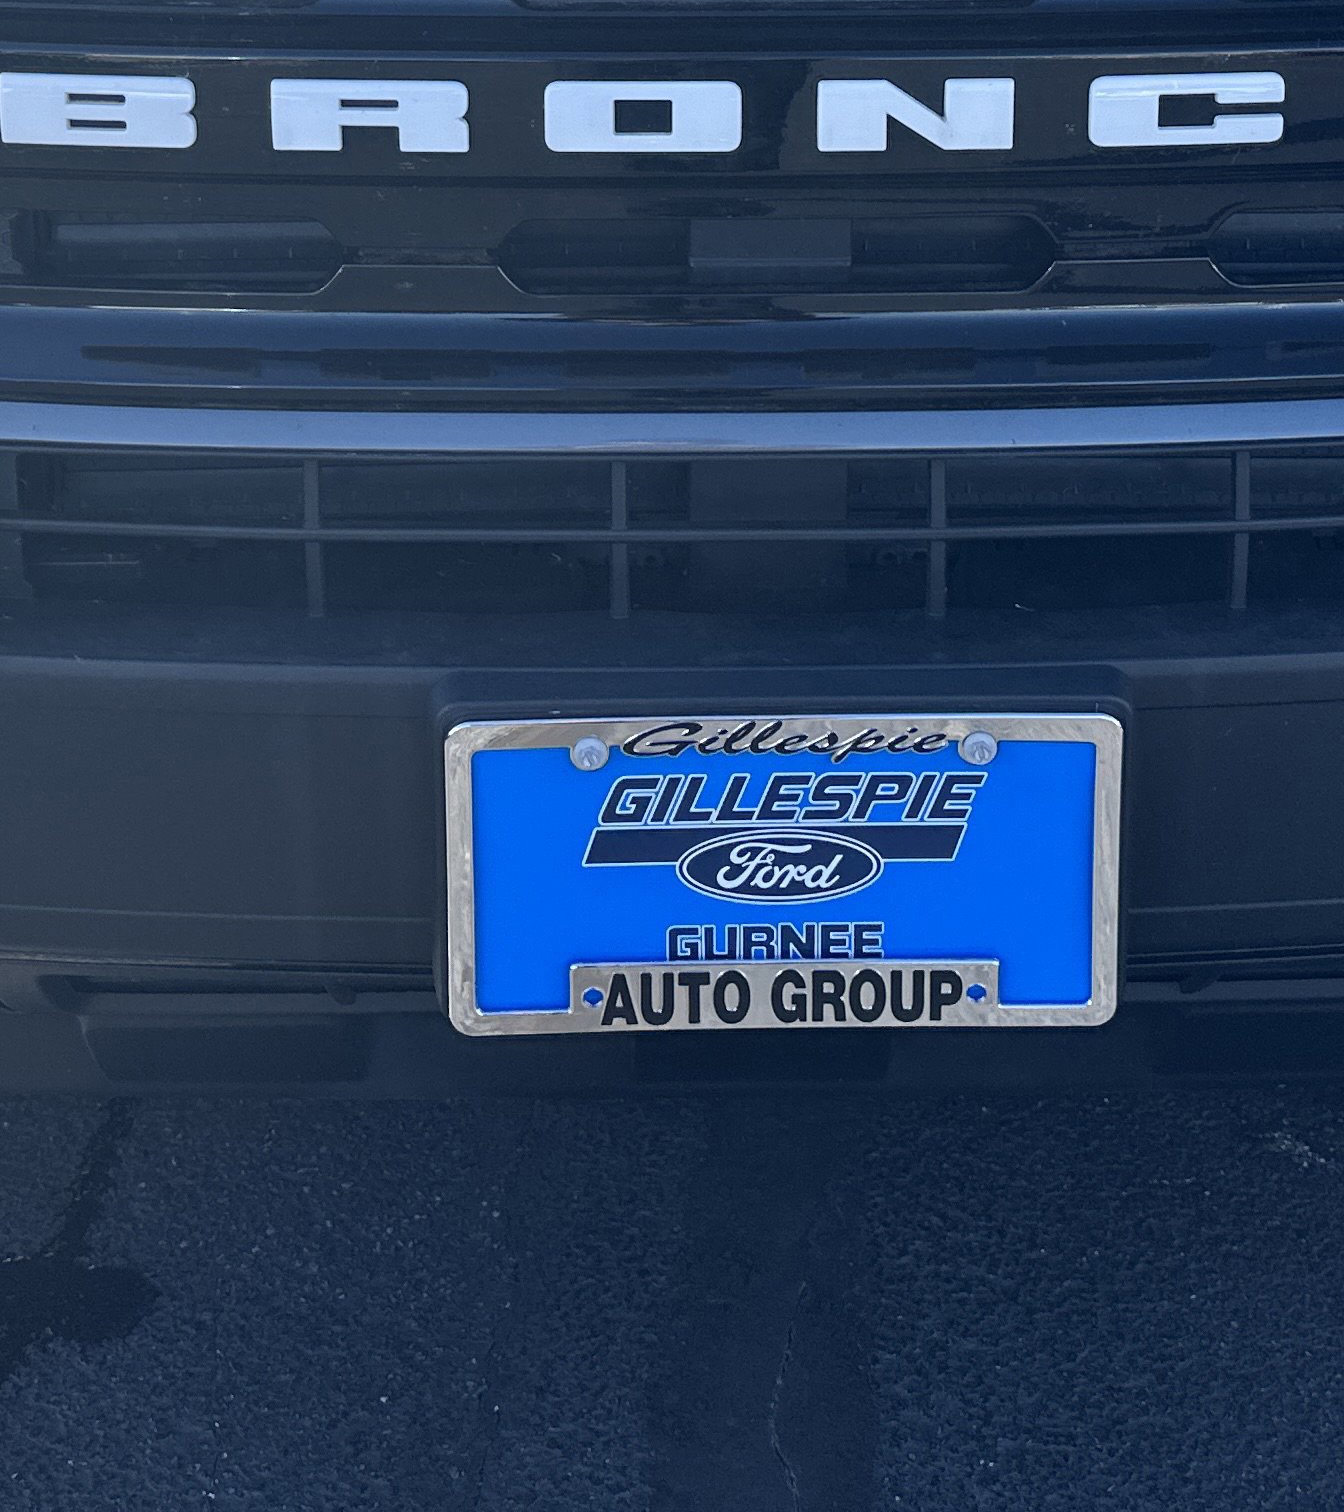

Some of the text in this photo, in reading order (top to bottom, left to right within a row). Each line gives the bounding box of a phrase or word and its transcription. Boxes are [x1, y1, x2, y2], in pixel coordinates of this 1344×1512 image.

[621, 719, 950, 764] Gillespie
[597, 771, 989, 826] GILLESPIE
[716, 842, 845, 890] Ford
[666, 921, 886, 962] GURNEE
[600, 968, 964, 1027] AUTO GROUP
